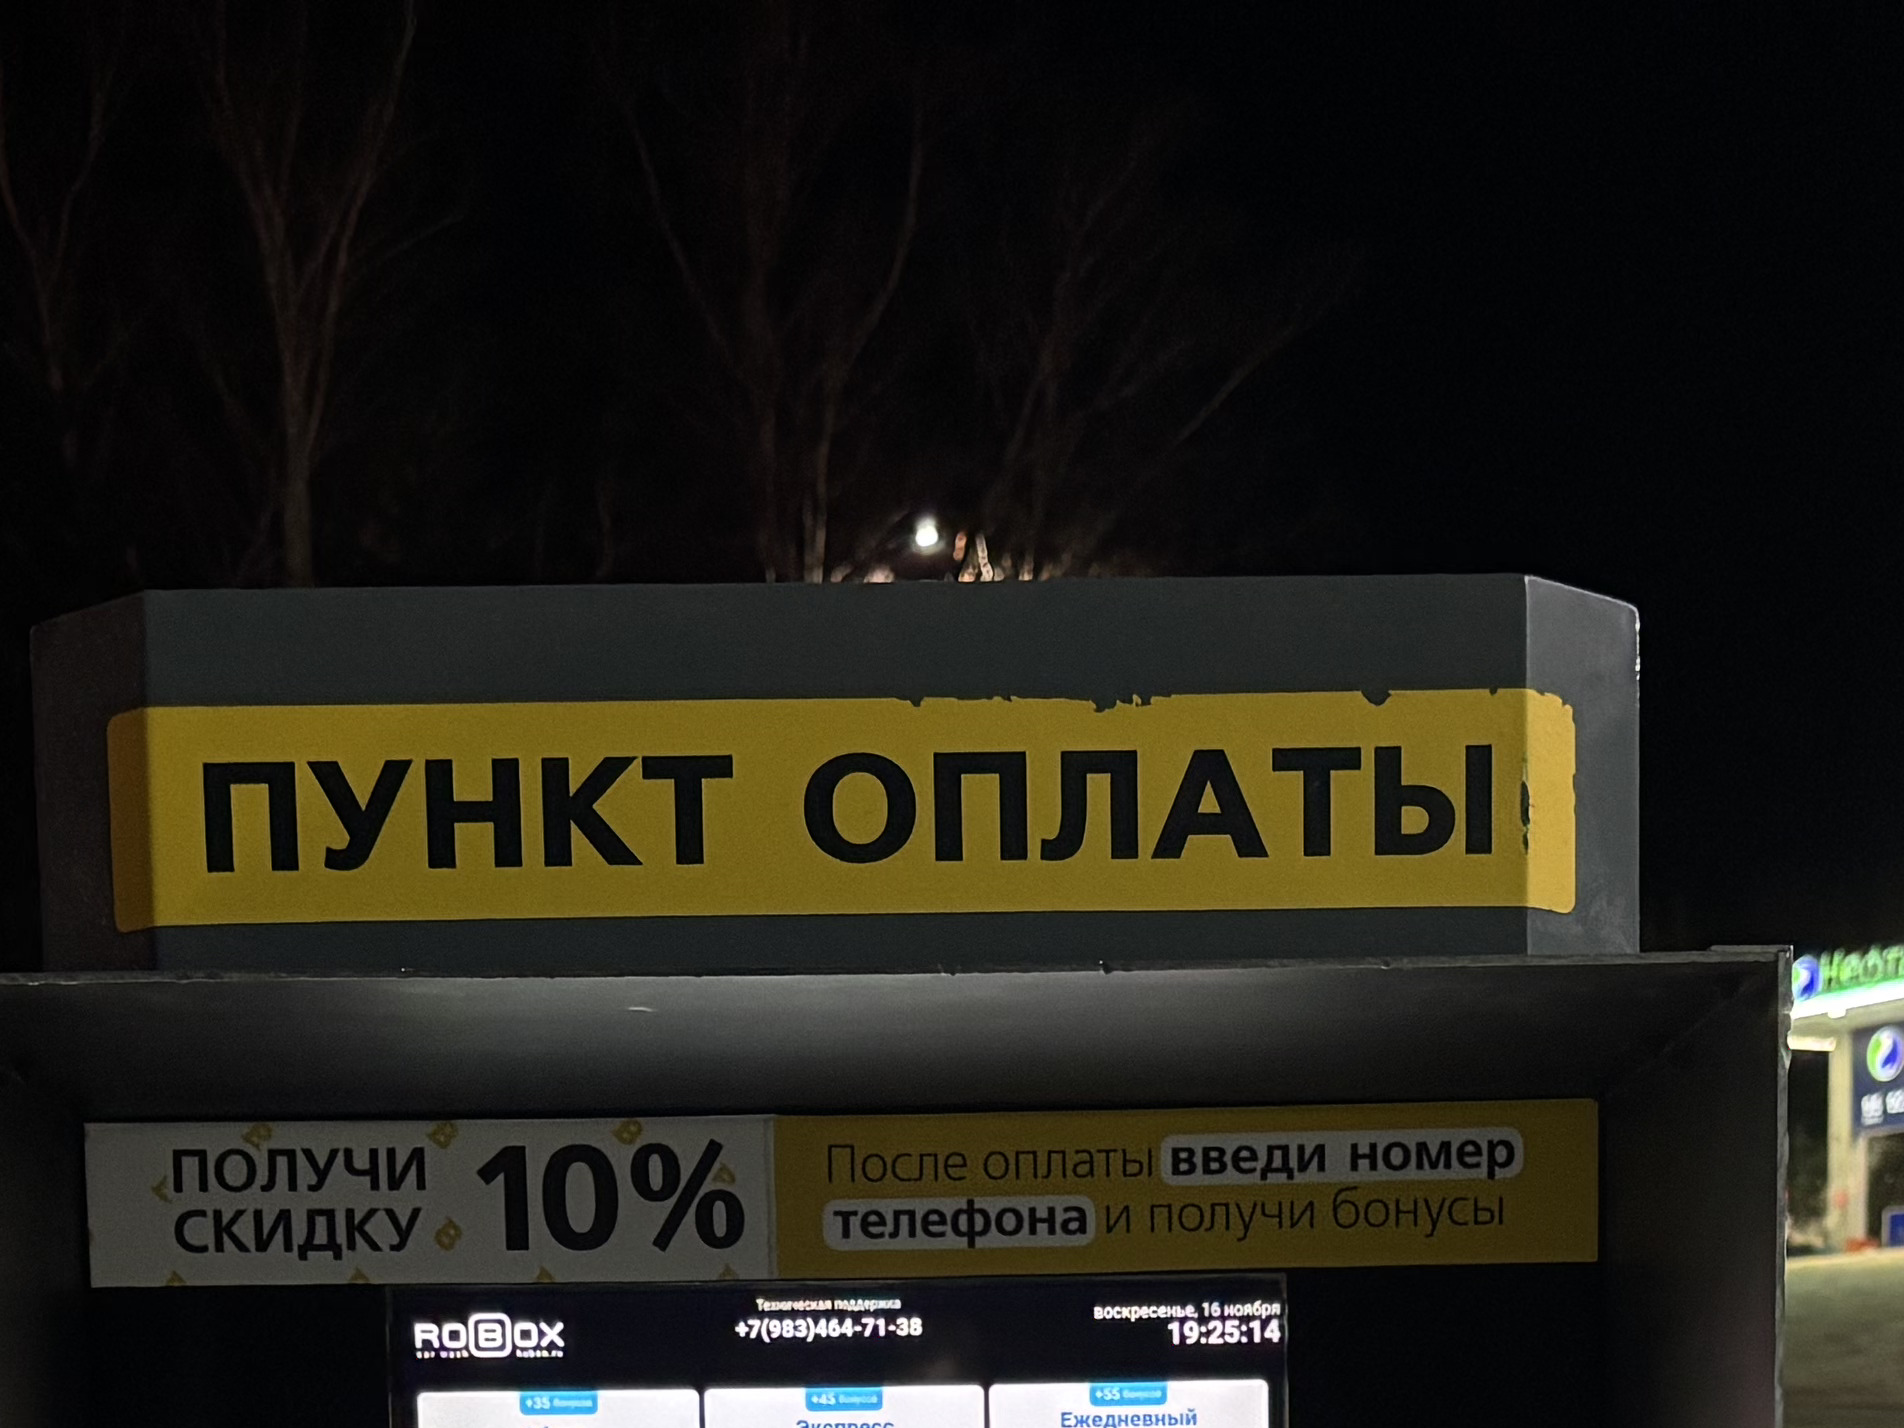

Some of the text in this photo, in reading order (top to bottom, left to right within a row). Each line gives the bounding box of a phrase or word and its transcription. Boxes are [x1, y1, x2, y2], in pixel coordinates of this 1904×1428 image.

[200, 744, 1494, 875] ПУНКТ ОПЛАТЫ
[172, 1146, 427, 1194] ПОЛУЧИ
[827, 1133, 1517, 1185] После оплаты введи номер
[476, 1138, 746, 1253] 10%
[833, 1186, 1506, 1250] телефона и получи бонусы
[173, 1207, 422, 1261] СКИДКУ
[734, 1317, 923, 1343] +7(983)464-71-38
[834, 1299, 901, 1312] поддержка
[1093, 1300, 1281, 1322] воскресенье, 16 ноября
[1167, 1319, 1281, 1345] 19:25:14
